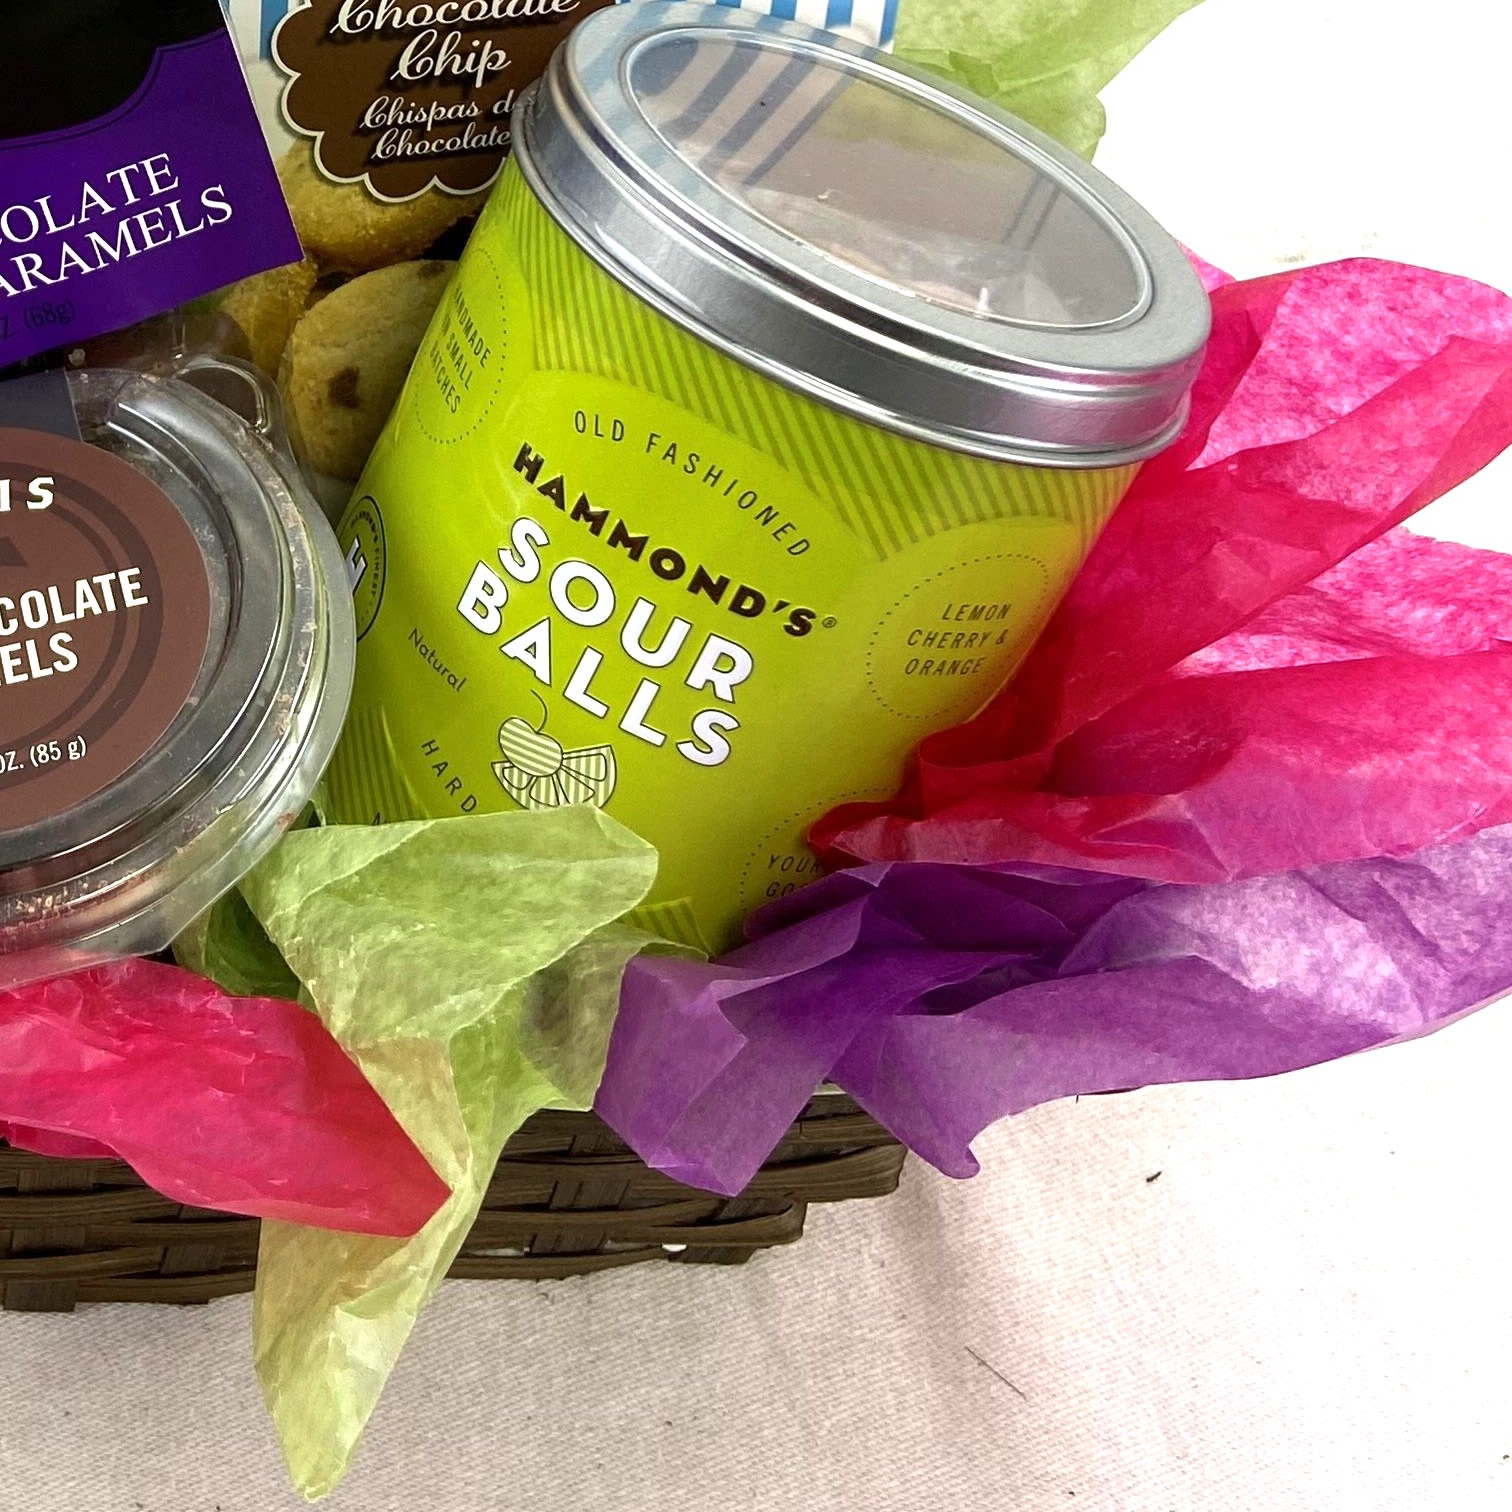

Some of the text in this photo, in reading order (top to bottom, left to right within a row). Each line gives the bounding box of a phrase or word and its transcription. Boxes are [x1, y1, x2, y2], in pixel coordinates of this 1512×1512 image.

[390, 28, 512, 89] Chip
[360, 89, 516, 131] Chispas d
[574, 409, 811, 558] OLD FASHIONED
[497, 516, 754, 704] SOUR
[906, 628, 1009, 650] CHERRY &
[941, 601, 1012, 622] LEMON
[407, 626, 468, 694] Natural
[456, 559, 741, 767] BALLS
[903, 656, 986, 678] ORANGE
[420, 738, 478, 813] HARD
